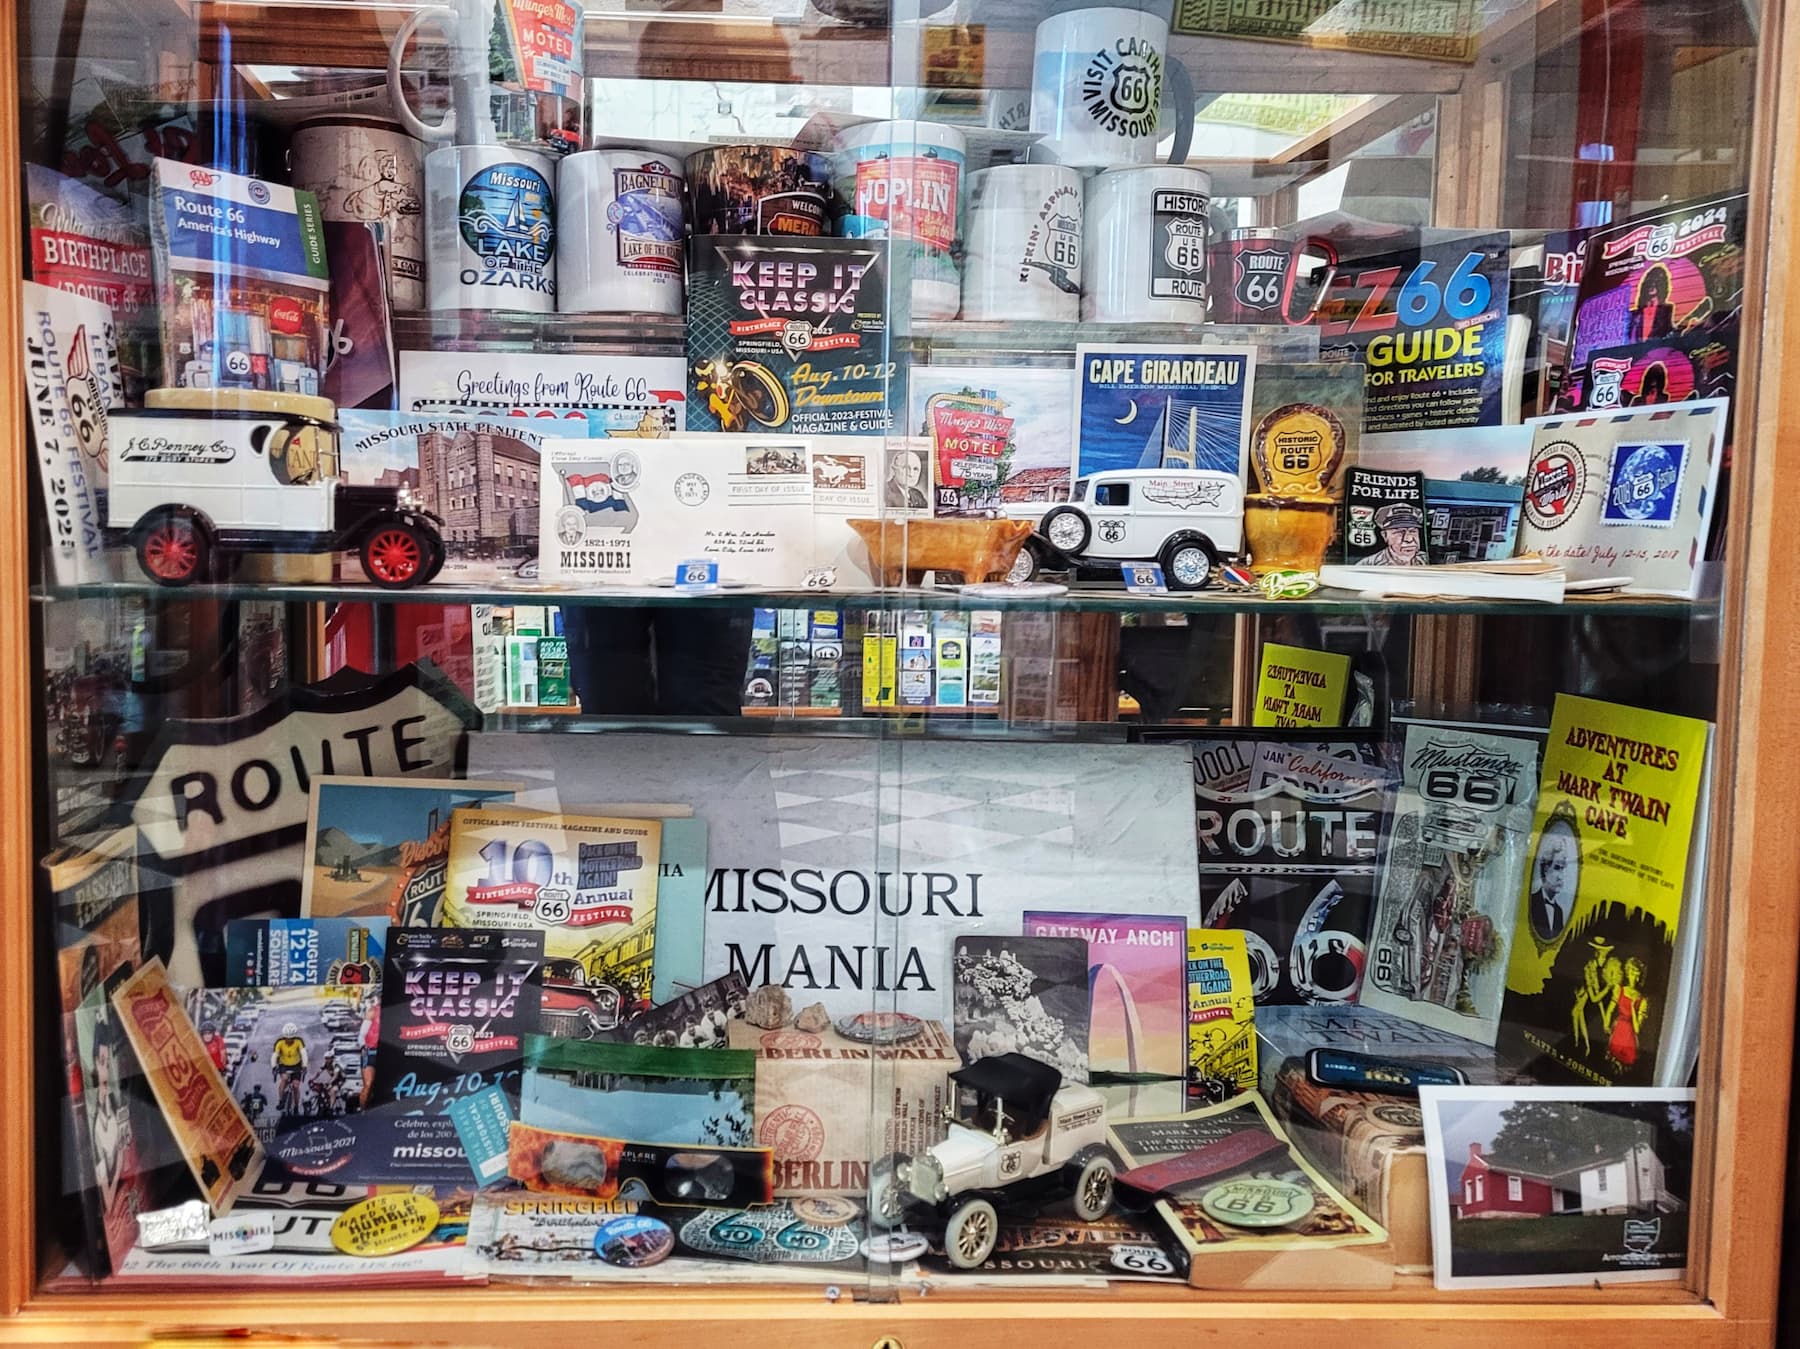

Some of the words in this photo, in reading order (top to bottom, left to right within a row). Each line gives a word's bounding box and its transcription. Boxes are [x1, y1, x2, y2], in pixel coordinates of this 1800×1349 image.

[522, 28, 569, 55] MOTEL
[1083, 49, 1113, 101] VISIT
[1115, 37, 1161, 108] CARTHAGE
[1121, 76, 1143, 103] 66
[1088, 99, 1157, 138] MISSOURI
[490, 171, 541, 194] Missouri
[862, 178, 950, 215] JOPLIN
[174, 196, 223, 220] Route
[225, 207, 246, 225] 66
[305, 203, 319, 233] SERIES
[1175, 223, 1202, 236] ROUTE
[1679, 207, 1727, 236] 2024
[178, 217, 232, 239] America's
[235, 228, 282, 249] Highway
[311, 233, 321, 264] GUIDE
[478, 238, 546, 262] LAKE
[1054, 242, 1076, 266] 66
[1652, 239, 1668, 254] 66
[42, 236, 148, 278] BIRTHPLACE
[484, 256, 509, 270] OF
[514, 259, 543, 275] THE
[1177, 249, 1199, 267] 66
[1249, 254, 1285, 270] ROUTE
[460, 268, 555, 296] OZARKS
[732, 260, 818, 289] KEEP
[833, 264, 866, 290] IT
[1172, 280, 1202, 297] ROUTE
[1246, 275, 1280, 303] 66
[739, 289, 856, 314] CLASSIC
[736, 321, 782, 333] BIRTHPLACE
[812, 327, 833, 335] 2023
[738, 340, 782, 349] SPRINGFIELD,
[789, 333, 807, 345] 66
[813, 337, 857, 348] FESTIVAL
[1367, 325, 1485, 368] GUIDE
[229, 354, 249, 371] 66
[792, 362, 838, 389] Aug.
[842, 362, 896, 381] 10-12
[1089, 359, 1136, 384] CAPE
[1141, 360, 1240, 385] GIRARDEAU
[1365, 371, 1395, 388] FOR
[1397, 361, 1486, 385] TRAVELERS
[27, 335, 56, 428] JUNE
[457, 369, 529, 403] Greetings
[534, 372, 571, 401] from
[574, 372, 621, 401] Route
[625, 377, 648, 401] 66
[796, 386, 885, 407] Downtown
[1597, 386, 1614, 402] 66
[71, 392, 95, 444] 66
[791, 412, 831, 424] OFFICIAL
[832, 411, 853, 422] 2023
[854, 408, 894, 420] FESTIVAL
[37, 310, 66, 399] ROUTE
[58, 408, 76, 437] 66
[67, 445, 100, 560] FESTIVAL
[792, 421, 849, 434] MAGAZINE
[850, 420, 858, 431] &
[859, 418, 894, 431] GUIDE
[355, 422, 425, 454] MISSOURI
[428, 421, 470, 433] STATE
[943, 437, 1000, 455] MOTEL
[1277, 435, 1319, 444] HISTORIC
[1280, 446, 1315, 455] ROUTE
[1283, 455, 1310, 470] 66
[960, 467, 972, 478] 75
[973, 471, 993, 479] YEARS
[1353, 471, 1418, 488] FRIENDS
[942, 490, 955, 503] 66
[1351, 484, 1383, 499] FOR
[1384, 487, 1420, 500] LIFE
[1637, 483, 1652, 497] 66
[850, 496, 870, 504] ISSUE
[584, 539, 631, 547] 1821-1971
[1105, 530, 1119, 541] 66
[1354, 533, 1372, 545] 66
[560, 551, 631, 569] MISSOURI
[1546, 545, 1560, 558] the
[1591, 546, 1618, 567] July
[687, 571, 706, 582] 66
[808, 574, 828, 588] 66
[1136, 574, 1154, 585] 66
[1263, 749, 1286, 764] JAN
[1565, 725, 1680, 772] ADVENTURES
[1411, 747, 1524, 779] Mustangs
[1602, 759, 1629, 785] AT
[169, 714, 434, 832] ROUTE
[1426, 770, 1502, 806] 66
[1556, 769, 1602, 804] MARK
[1609, 785, 1671, 827] TWAIN
[463, 817, 499, 827] OFFICIAL
[521, 820, 559, 830] FESTIVAL
[561, 824, 602, 833] MAGAZINE
[604, 827, 622, 835] AND
[623, 828, 649, 836] GUIDE
[1584, 805, 1629, 840] CAVE
[1197, 808, 1377, 857] ROUTE
[478, 839, 574, 888] 10th
[578, 872, 618, 890] AGAIN!
[475, 886, 534, 900] BIRTHPLACE
[543, 891, 565, 899] ROUTE
[574, 888, 634, 905] Annual
[704, 867, 985, 918] MISSOURI
[524, 899, 535, 908] OF
[541, 902, 565, 918] 66
[472, 919, 512, 928] MISSOURI
[517, 921, 534, 929] USA
[475, 911, 532, 921] SPRINGFIELD,
[572, 909, 628, 923] FESTIVAL
[1035, 926, 1119, 945] GATEWAY
[1127, 928, 1175, 947] ARCH
[268, 929, 282, 986] SQUARE
[289, 928, 306, 984] 12-14
[306, 928, 320, 985] AUGUST
[1376, 947, 1392, 982] 66
[723, 942, 937, 992] MANIA
[405, 970, 481, 996] KEEP
[495, 973, 525, 996] IT
[1200, 980, 1232, 995] AGAIN!
[409, 997, 515, 1018] CLASSIC
[1193, 996, 1233, 1010] Annual
[1193, 1010, 1230, 1021] FESTIVAL
[452, 1036, 469, 1048] 66
[475, 1039, 514, 1051] FESTIVAL
[762, 1048, 870, 1060] BERLIN
[876, 1048, 955, 1060] WALL
[1523, 1029, 1558, 1059] WEAVER
[1567, 1056, 1613, 1088] JOHNSON
[394, 1119, 431, 1130] Celebre,
[1151, 1128, 1190, 1137] MARK
[1192, 1127, 1233, 1136] TWAIN
[334, 1136, 357, 1150] 2021
[420, 1130, 433, 1139] los
[772, 1160, 871, 1191] BERLIN
[1226, 1199, 1276, 1213] 66
[348, 1205, 418, 1235] HUMBLE
[1119, 1246, 1160, 1257] ROUTE
[1123, 1255, 1168, 1273] 66
